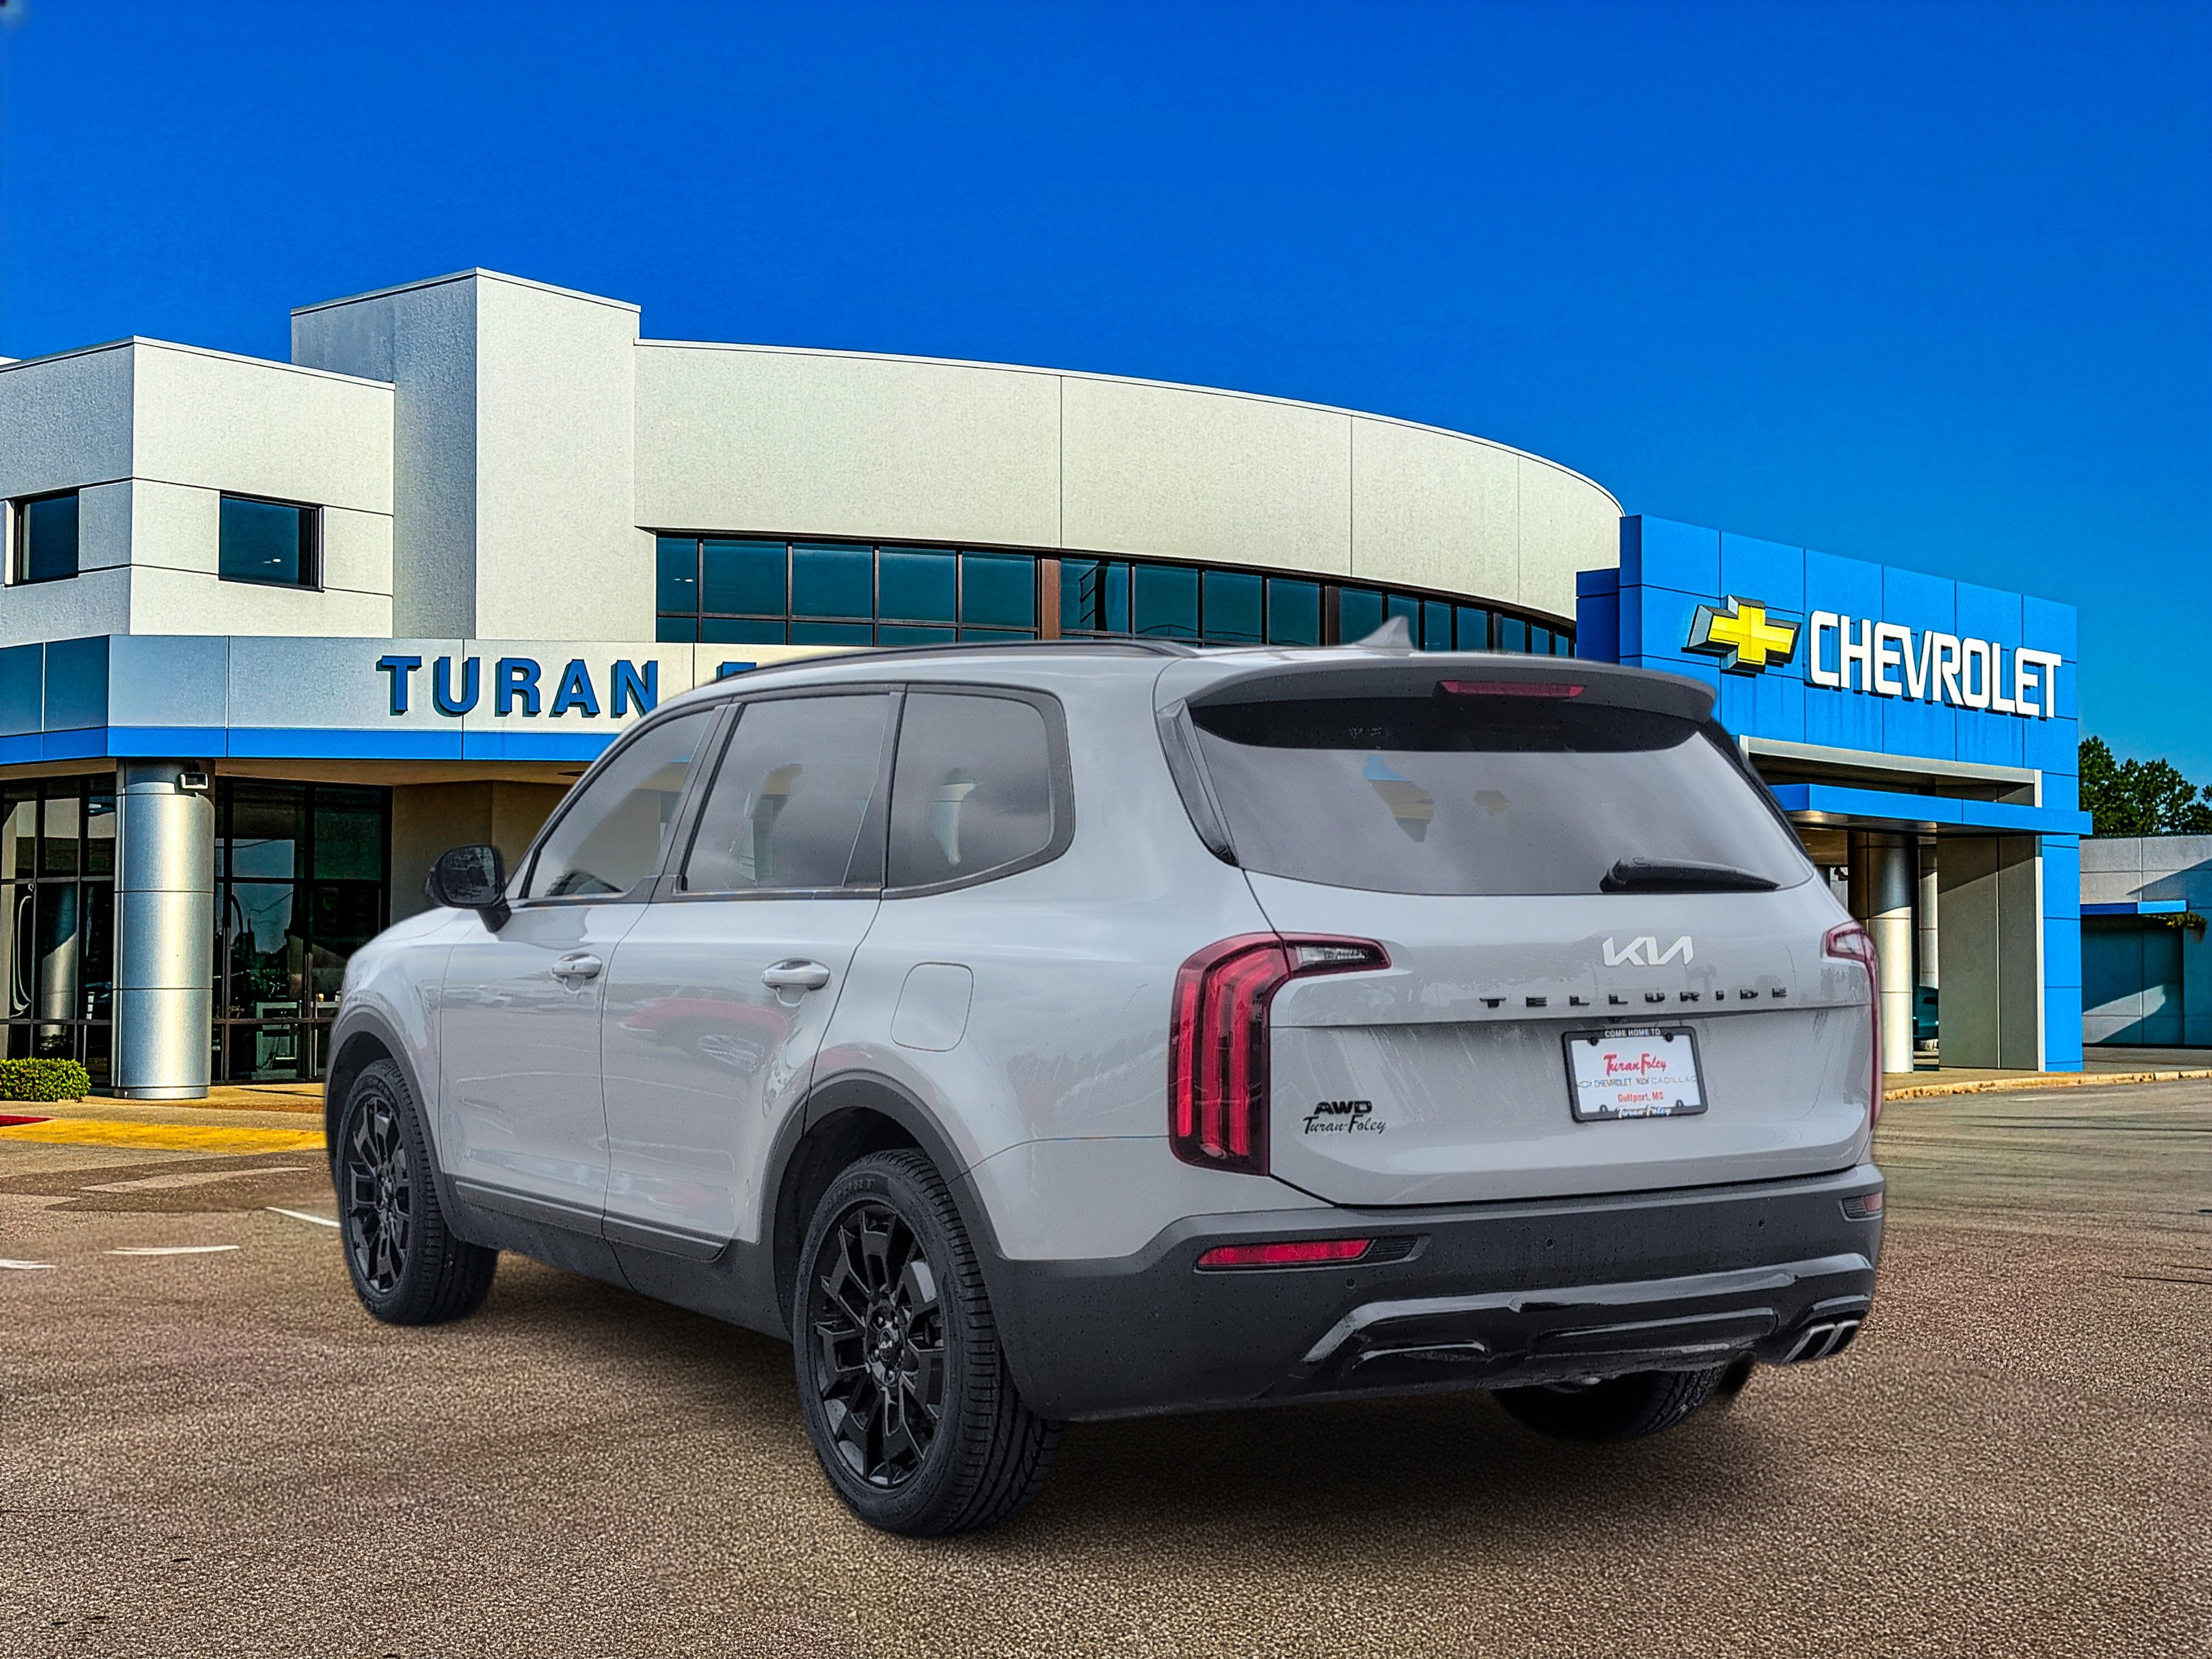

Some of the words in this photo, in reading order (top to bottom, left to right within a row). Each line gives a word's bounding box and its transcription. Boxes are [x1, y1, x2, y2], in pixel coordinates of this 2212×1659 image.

[1806, 609, 2062, 720] CHEVROLET
[376, 655, 658, 718] TURAN
[1603, 936, 1694, 966] KIA
[1480, 987, 1787, 1008] TELLURIDE
[1651, 1075, 1697, 1084] CADILLAC
[1652, 1091, 1663, 1100] MS
[1314, 1100, 1372, 1115] AWD
